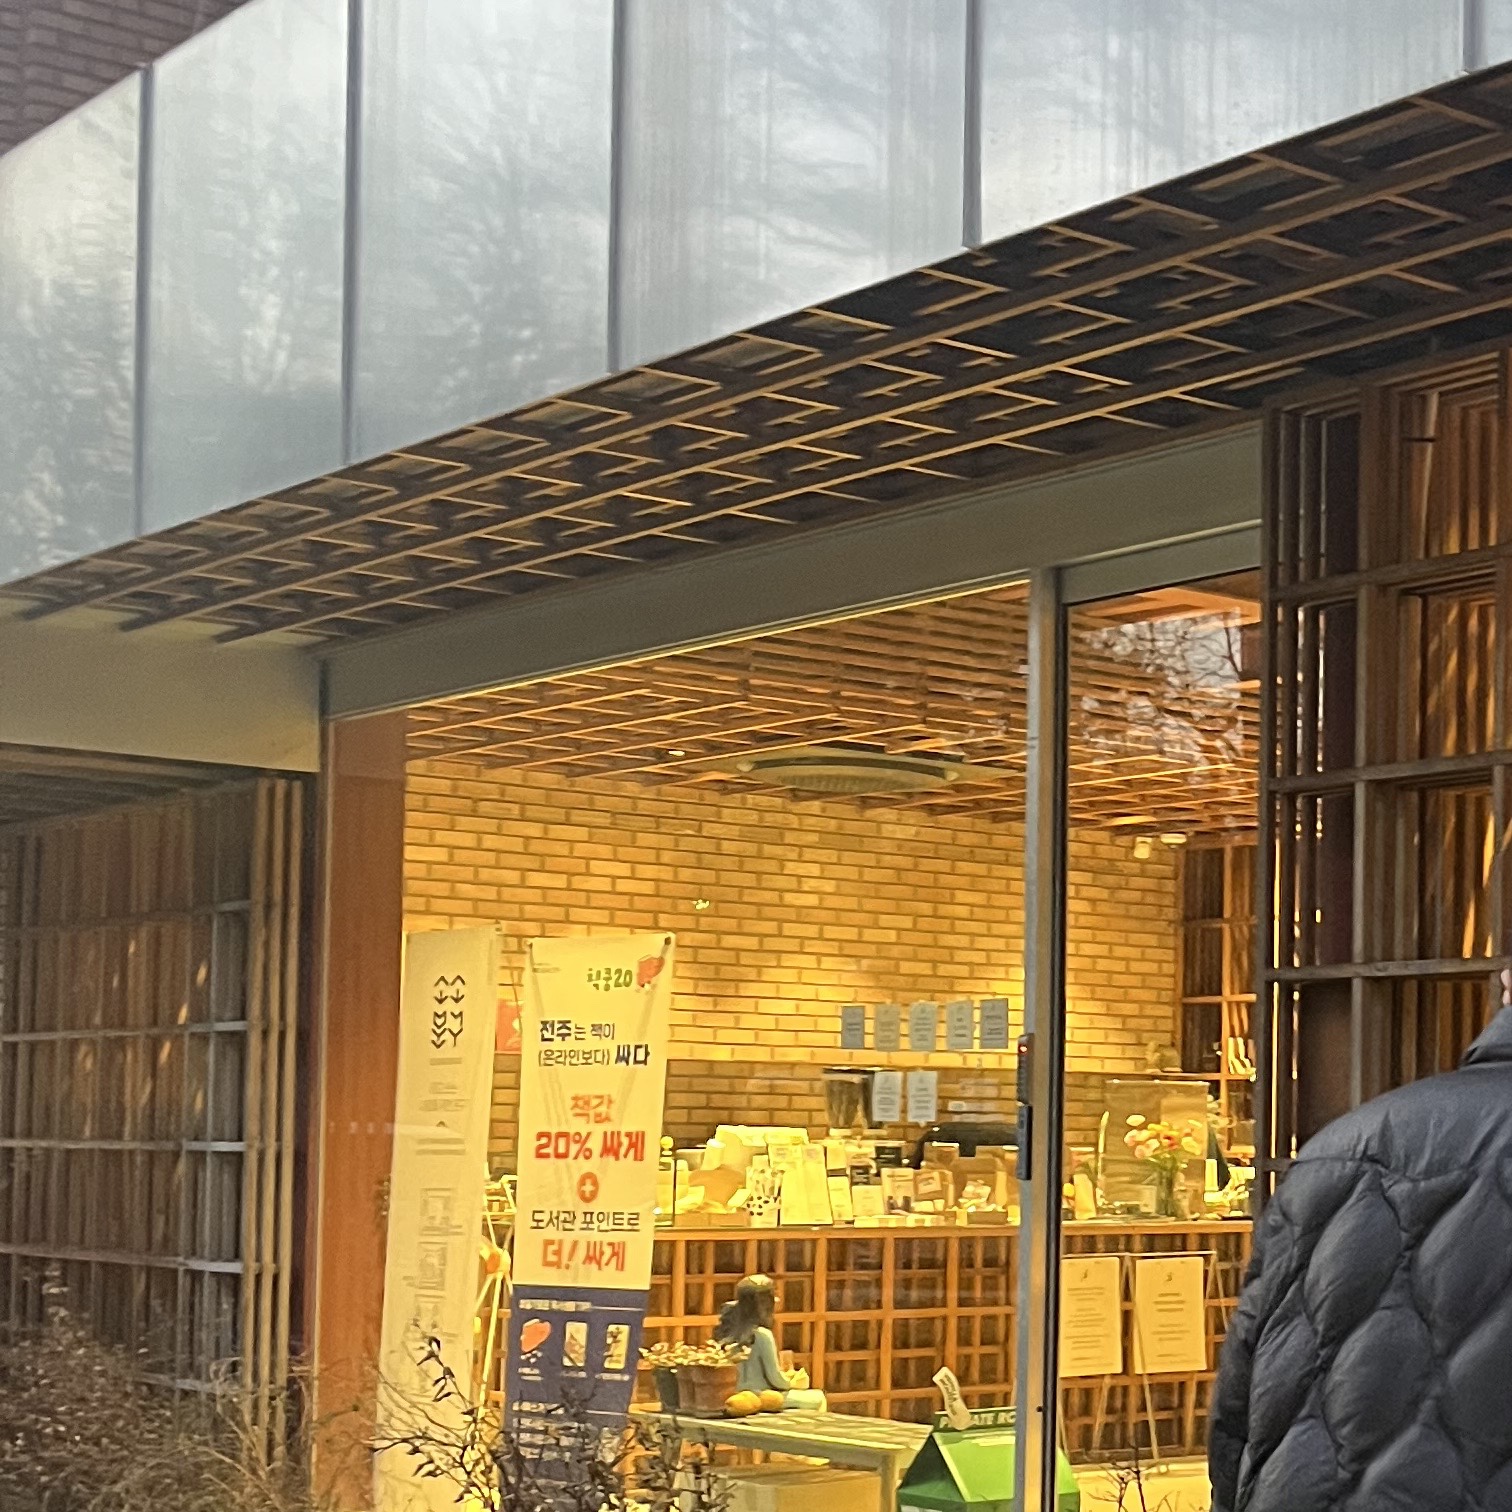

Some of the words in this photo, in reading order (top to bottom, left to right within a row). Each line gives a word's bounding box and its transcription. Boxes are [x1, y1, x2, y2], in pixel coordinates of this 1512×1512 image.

[540, 1019, 586, 1042] 전주는
[538, 1047, 611, 1067] (온라인보다)
[614, 1043, 650, 1066] 싸다
[570, 1093, 614, 1124] 책값
[534, 1130, 593, 1161] 20%
[600, 1130, 646, 1162] 싸게
[529, 1209, 577, 1232] 도서관
[579, 1210, 641, 1232] 포인트로
[541, 1238, 579, 1270] 더!
[581, 1240, 626, 1272] 싸게
